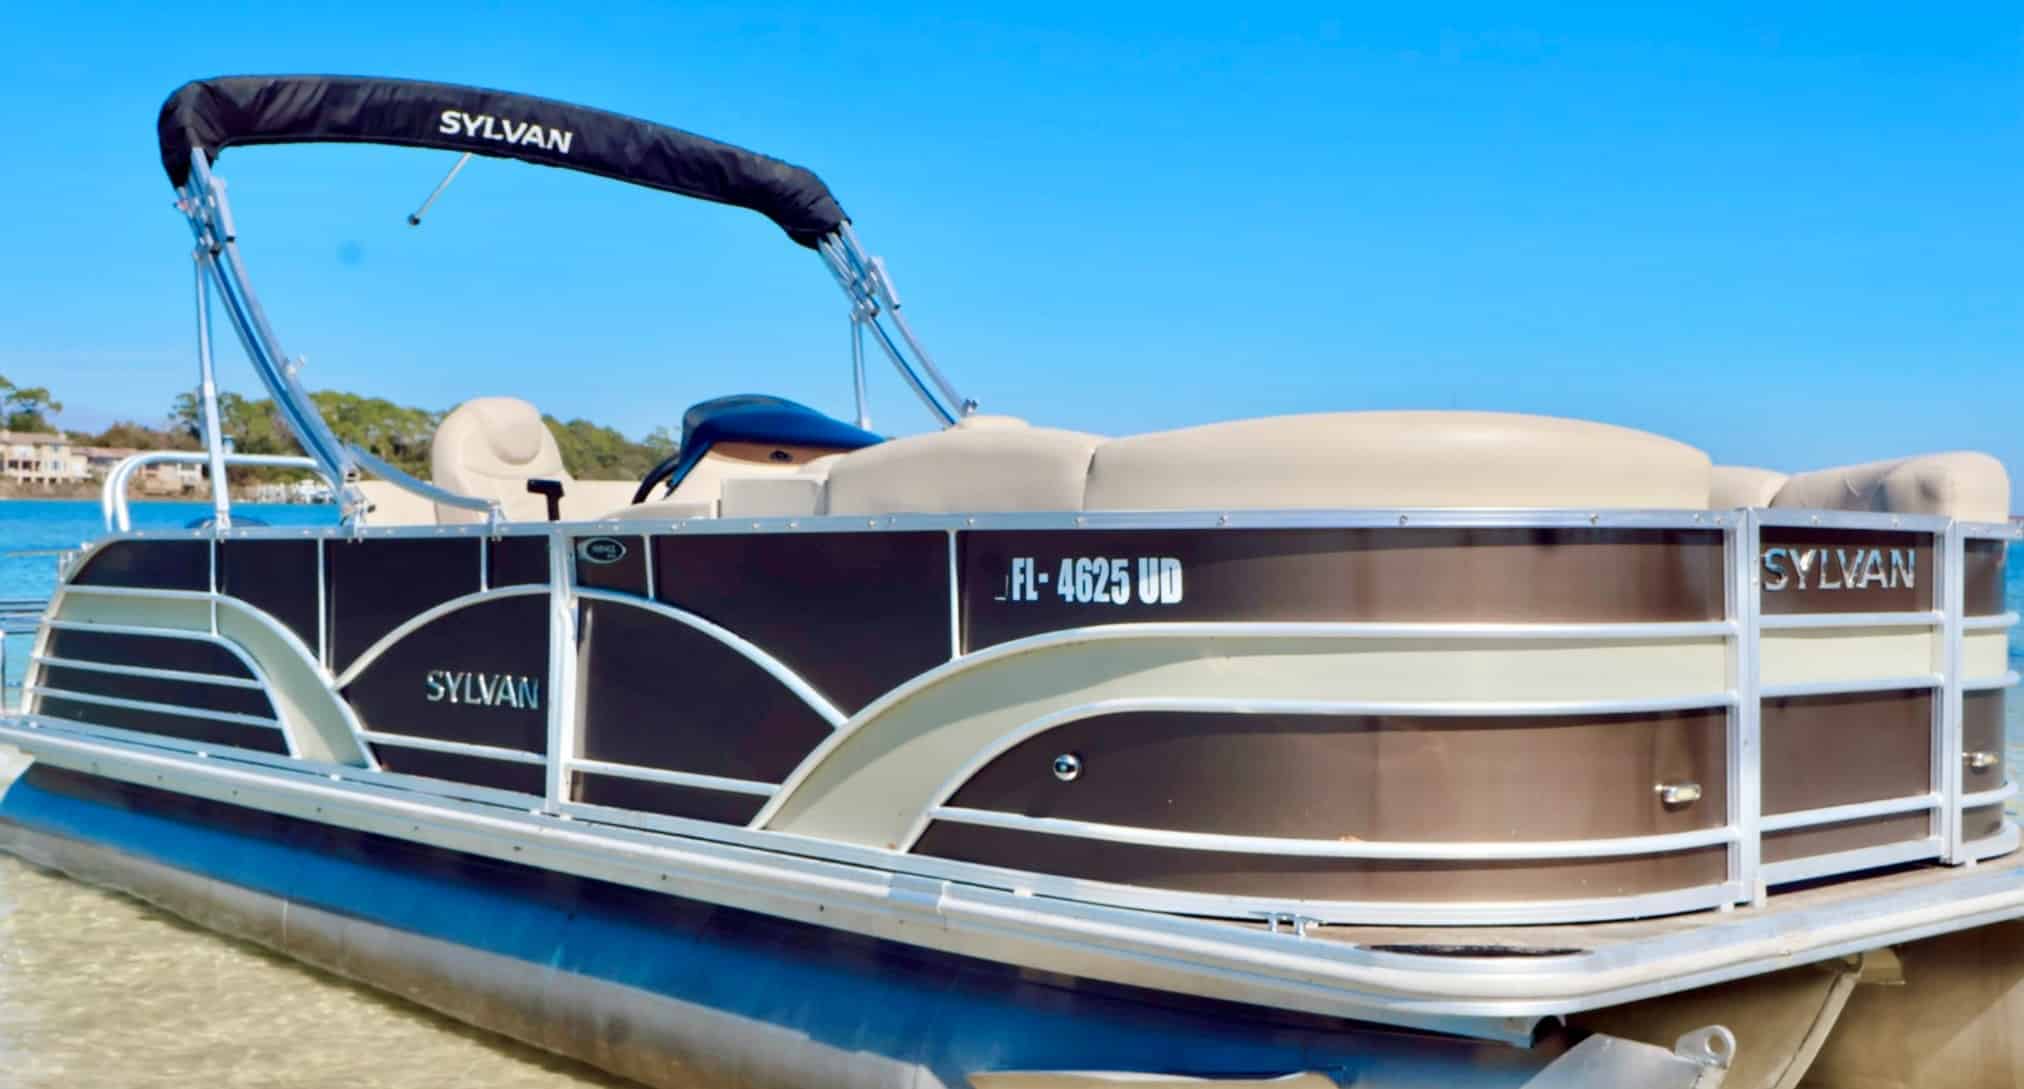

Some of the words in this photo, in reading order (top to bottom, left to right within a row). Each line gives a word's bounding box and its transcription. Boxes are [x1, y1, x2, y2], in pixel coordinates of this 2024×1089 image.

[439, 109, 574, 155] SYLVAN
[1057, 557, 1131, 605] 4625
[1138, 557, 1184, 605] UD
[1763, 547, 1917, 591] SYLVAN
[426, 669, 540, 710] SYLVAN
